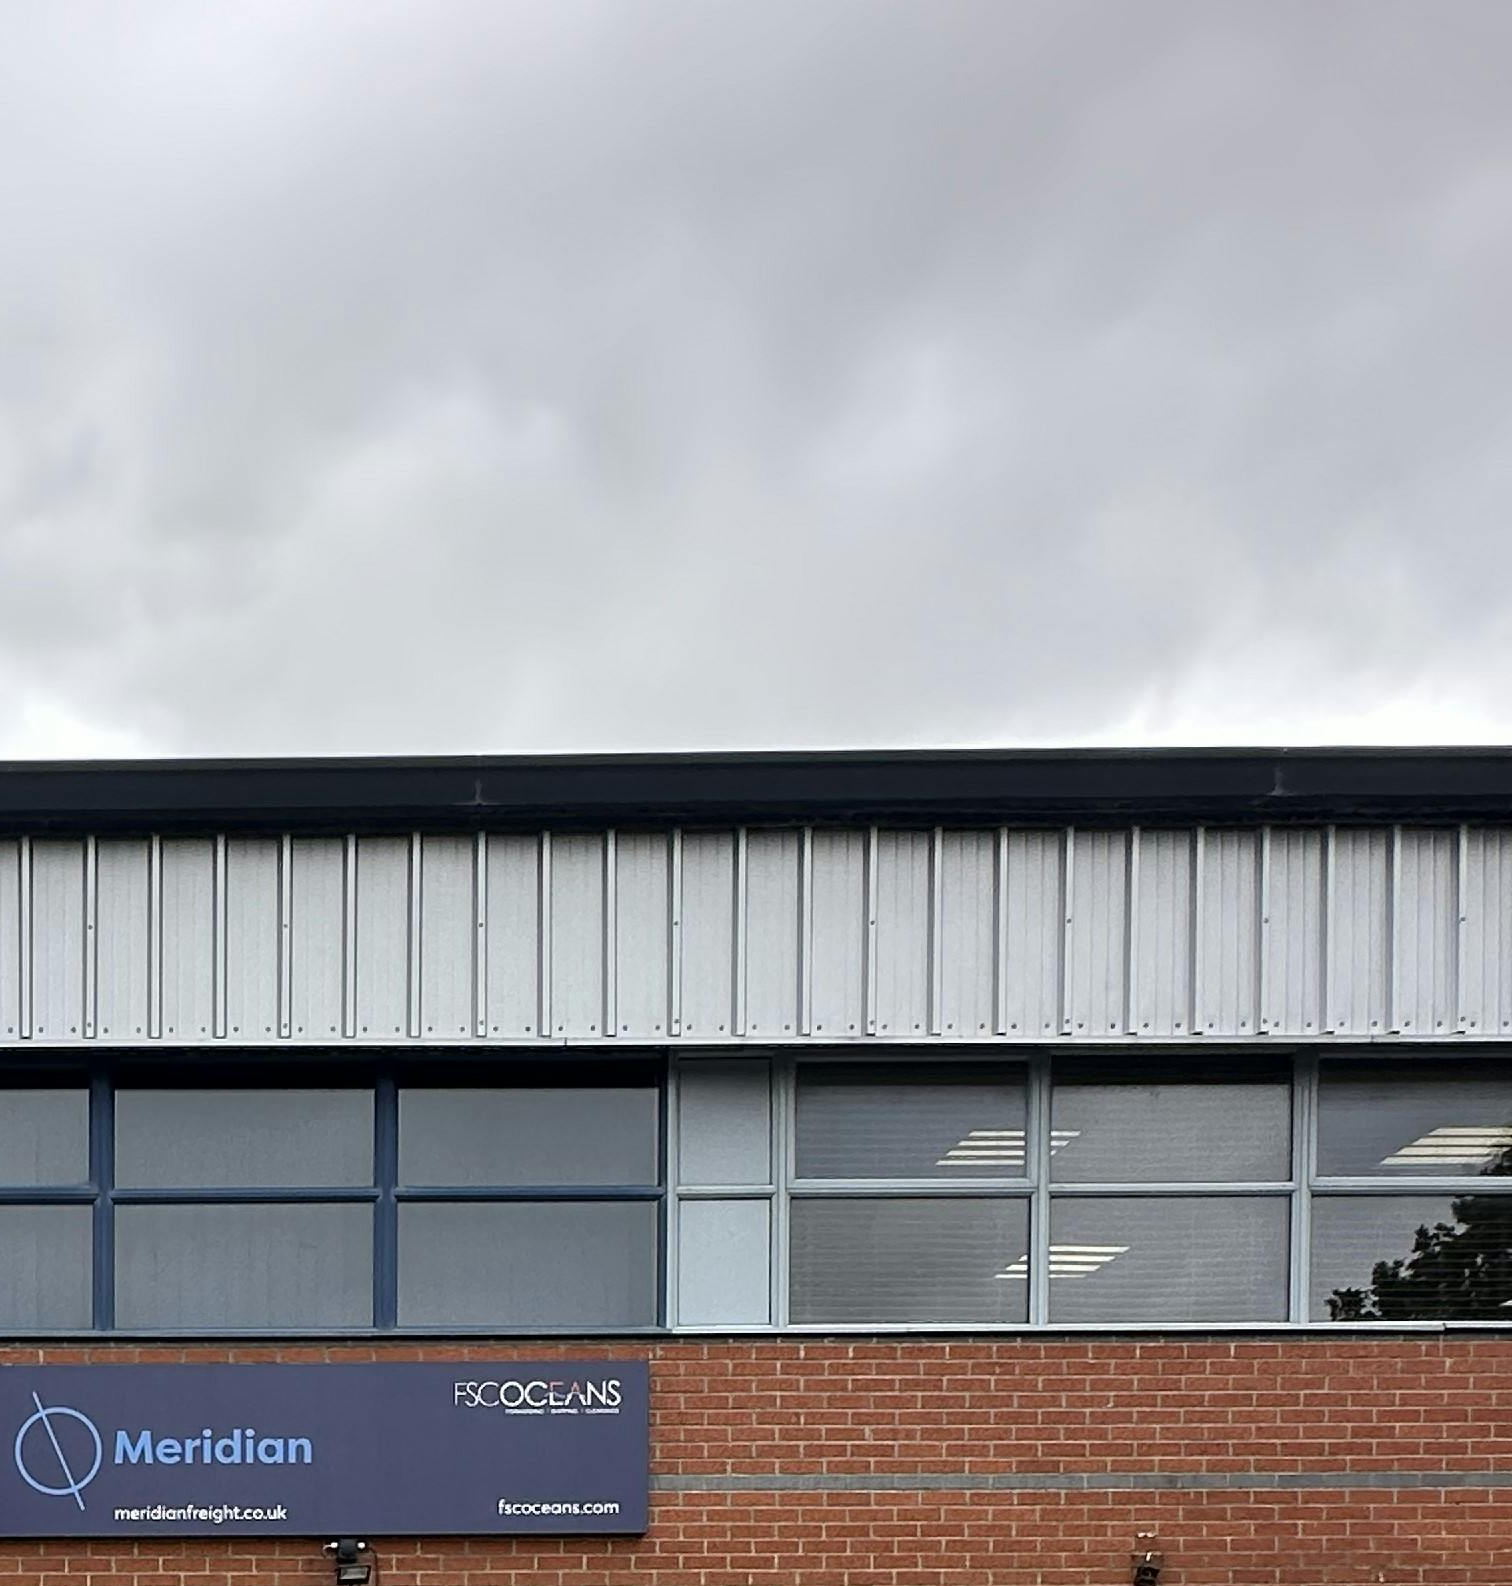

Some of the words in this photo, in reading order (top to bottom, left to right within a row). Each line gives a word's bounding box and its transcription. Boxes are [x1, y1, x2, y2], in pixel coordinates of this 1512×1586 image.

[113, 1428, 313, 1465] Meridian
[113, 1504, 288, 1524] meridianfreight.co.uk
[498, 1498, 620, 1515] fscoceans.com
